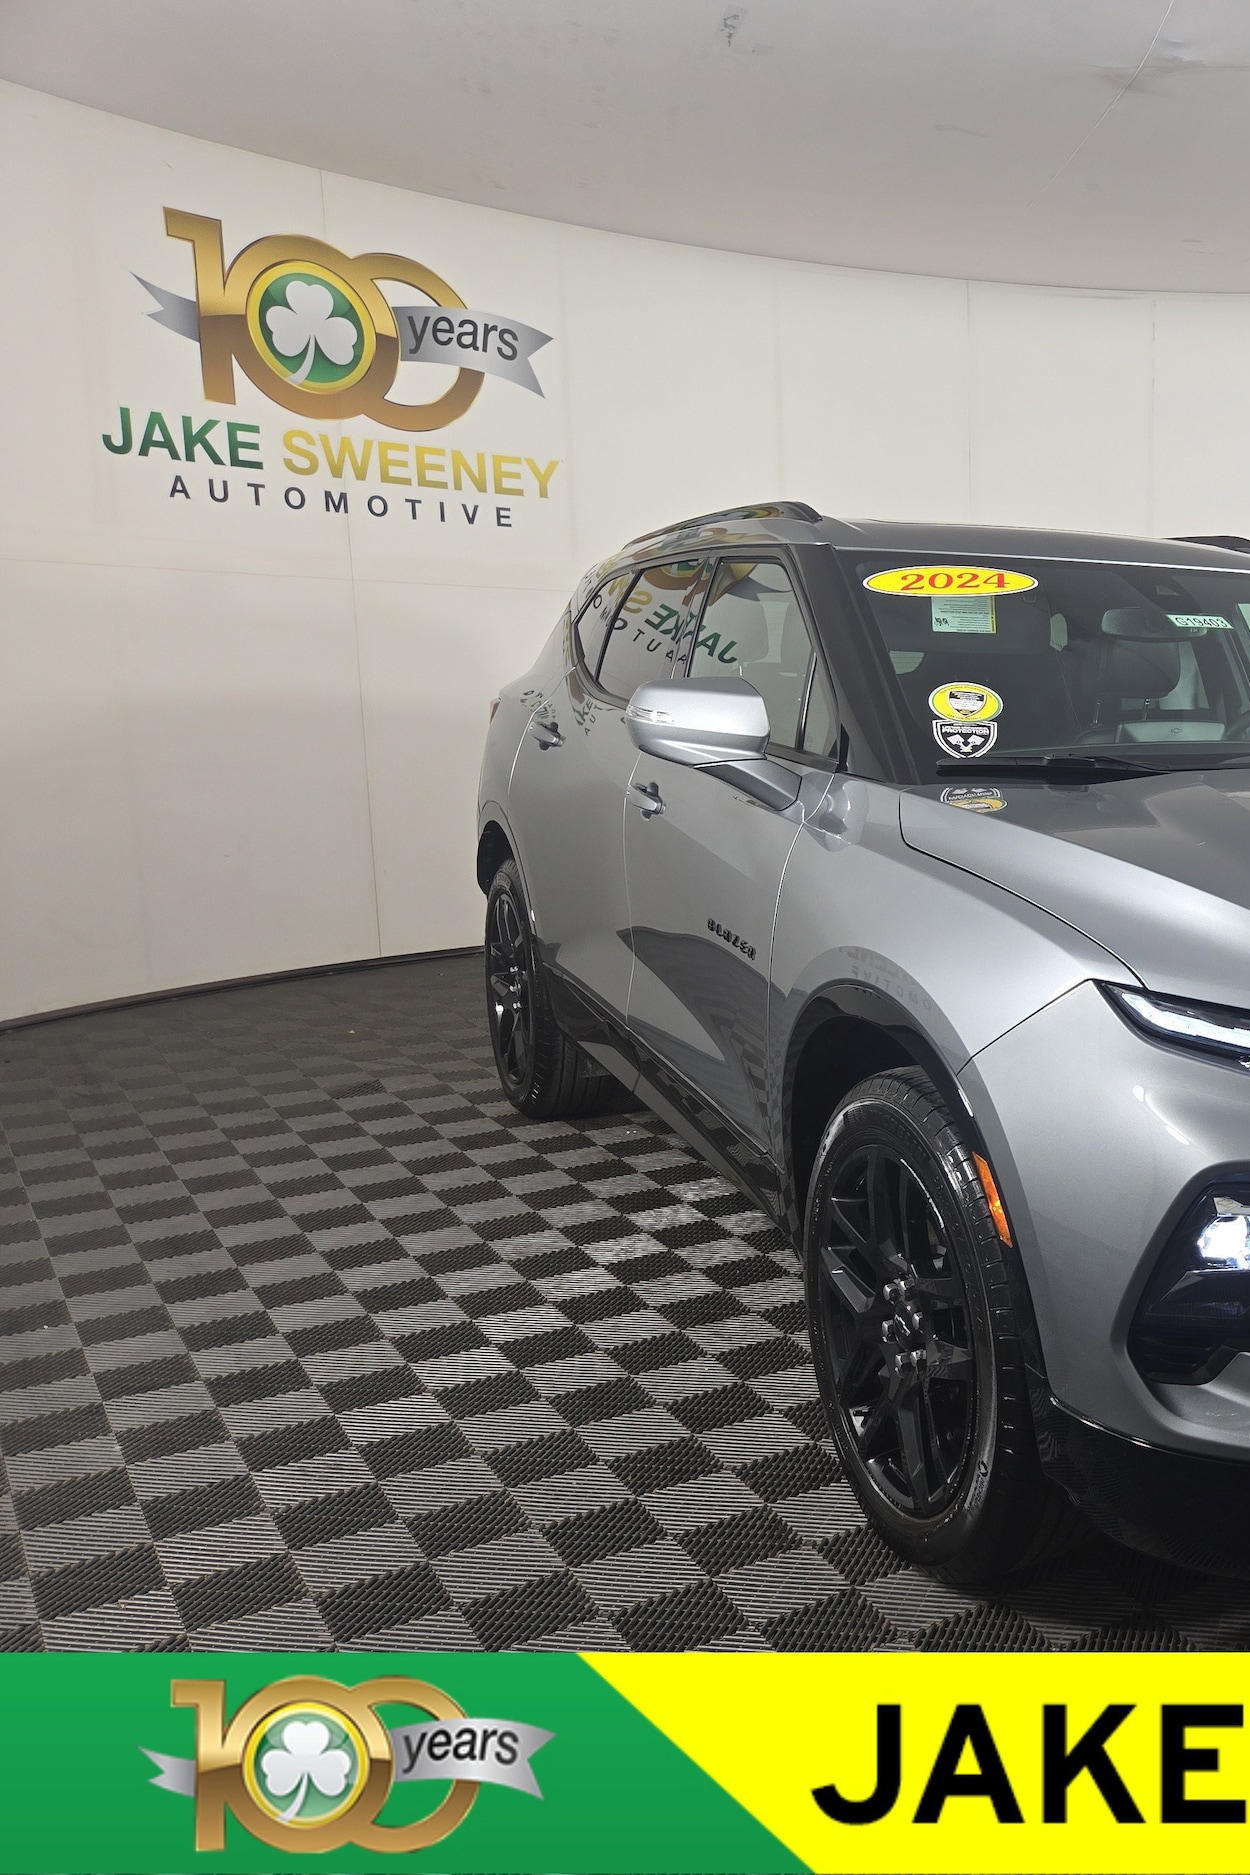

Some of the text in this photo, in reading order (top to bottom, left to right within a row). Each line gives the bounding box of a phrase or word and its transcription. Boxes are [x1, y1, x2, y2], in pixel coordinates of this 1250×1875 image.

[407, 312, 519, 361] years
[101, 406, 561, 500] JAKE SWEENEY
[168, 474, 514, 529] AUTOMOTIVE
[901, 572, 1011, 592] 2024
[1175, 616, 1228, 628] G19403
